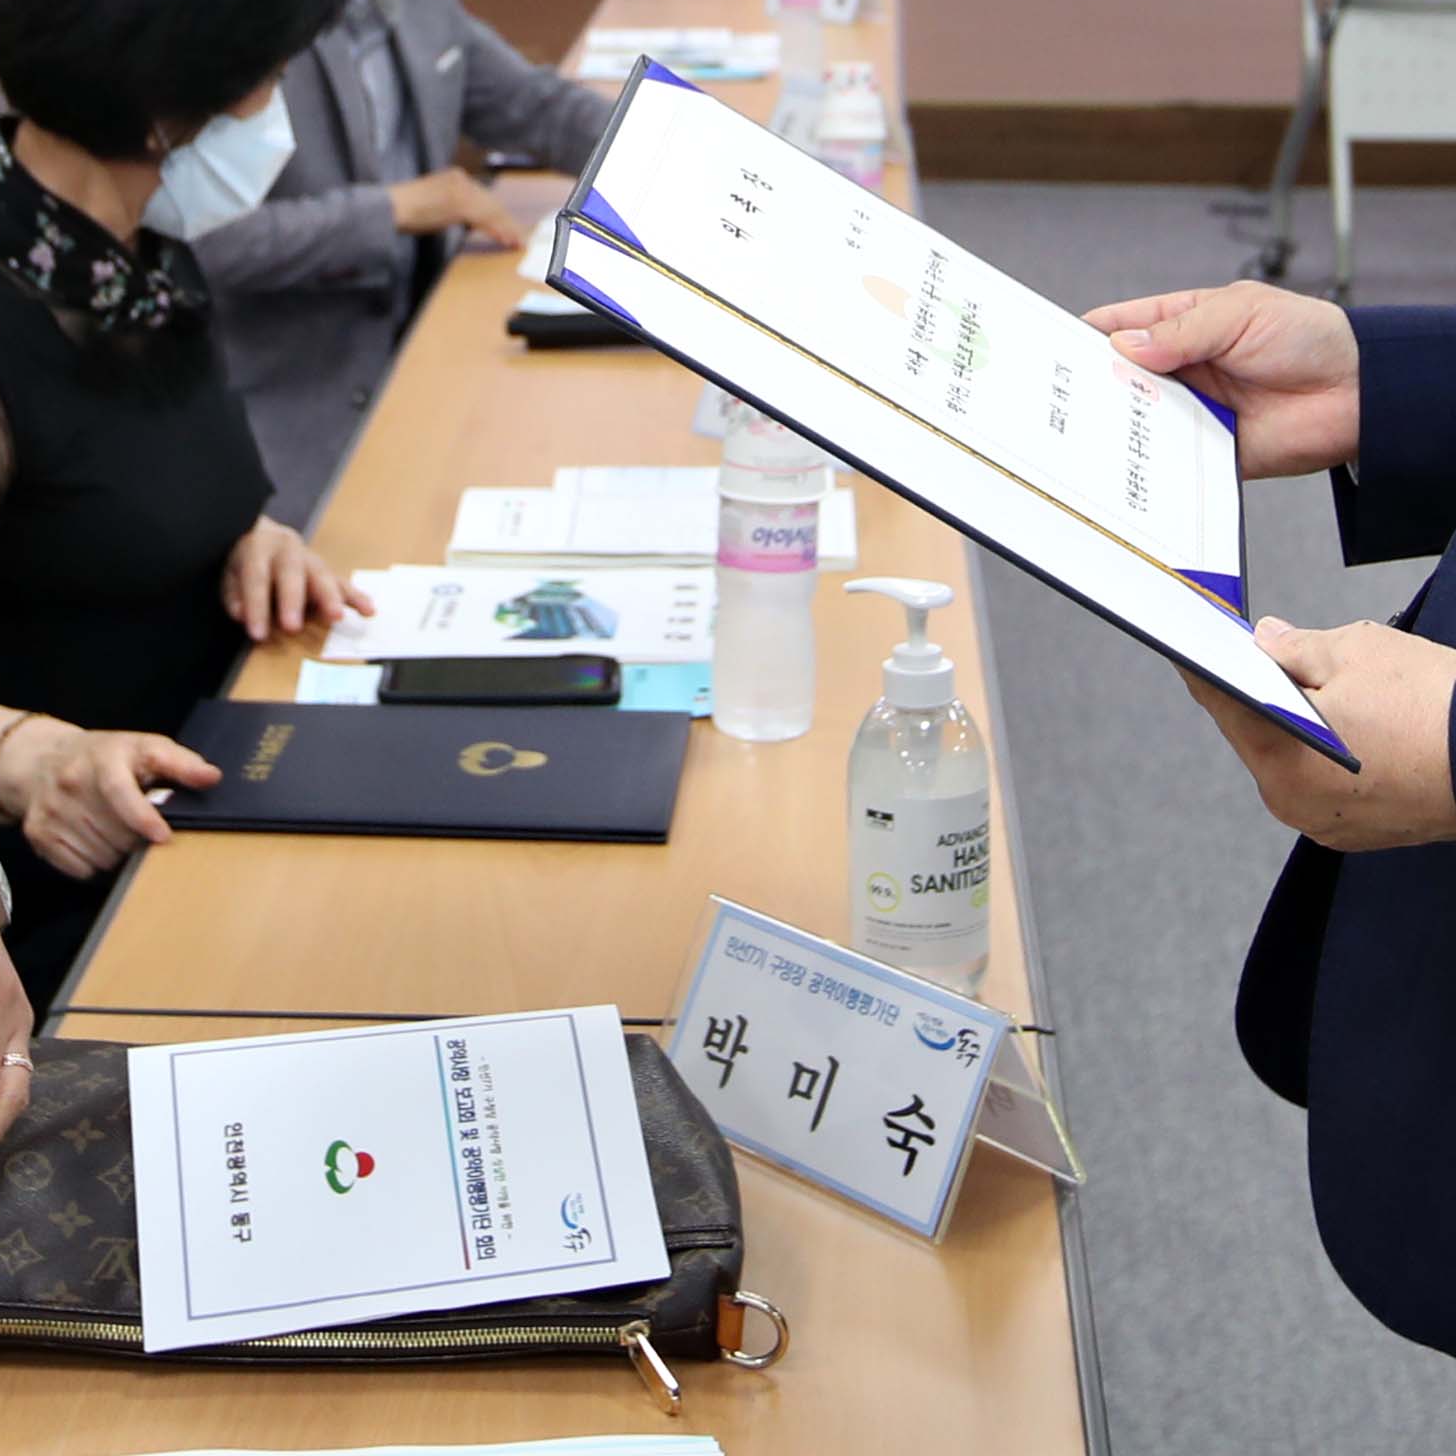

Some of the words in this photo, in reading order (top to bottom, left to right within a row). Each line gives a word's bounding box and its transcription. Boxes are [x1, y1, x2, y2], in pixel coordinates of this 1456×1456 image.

[954, 836, 990, 868] HAN
[770, 955, 808, 986] 구청장
[808, 972, 900, 1026] 공약이행평가단
[446, 1039, 472, 1082] 공약사항
[454, 1087, 478, 1123] 보고회
[459, 1128, 480, 1141] 및
[224, 1122, 250, 1204] 인천광역시
[462, 1146, 493, 1230] 공약이행평가단
[230, 1212, 252, 1243] 동구
[475, 1235, 497, 1261] 회의
